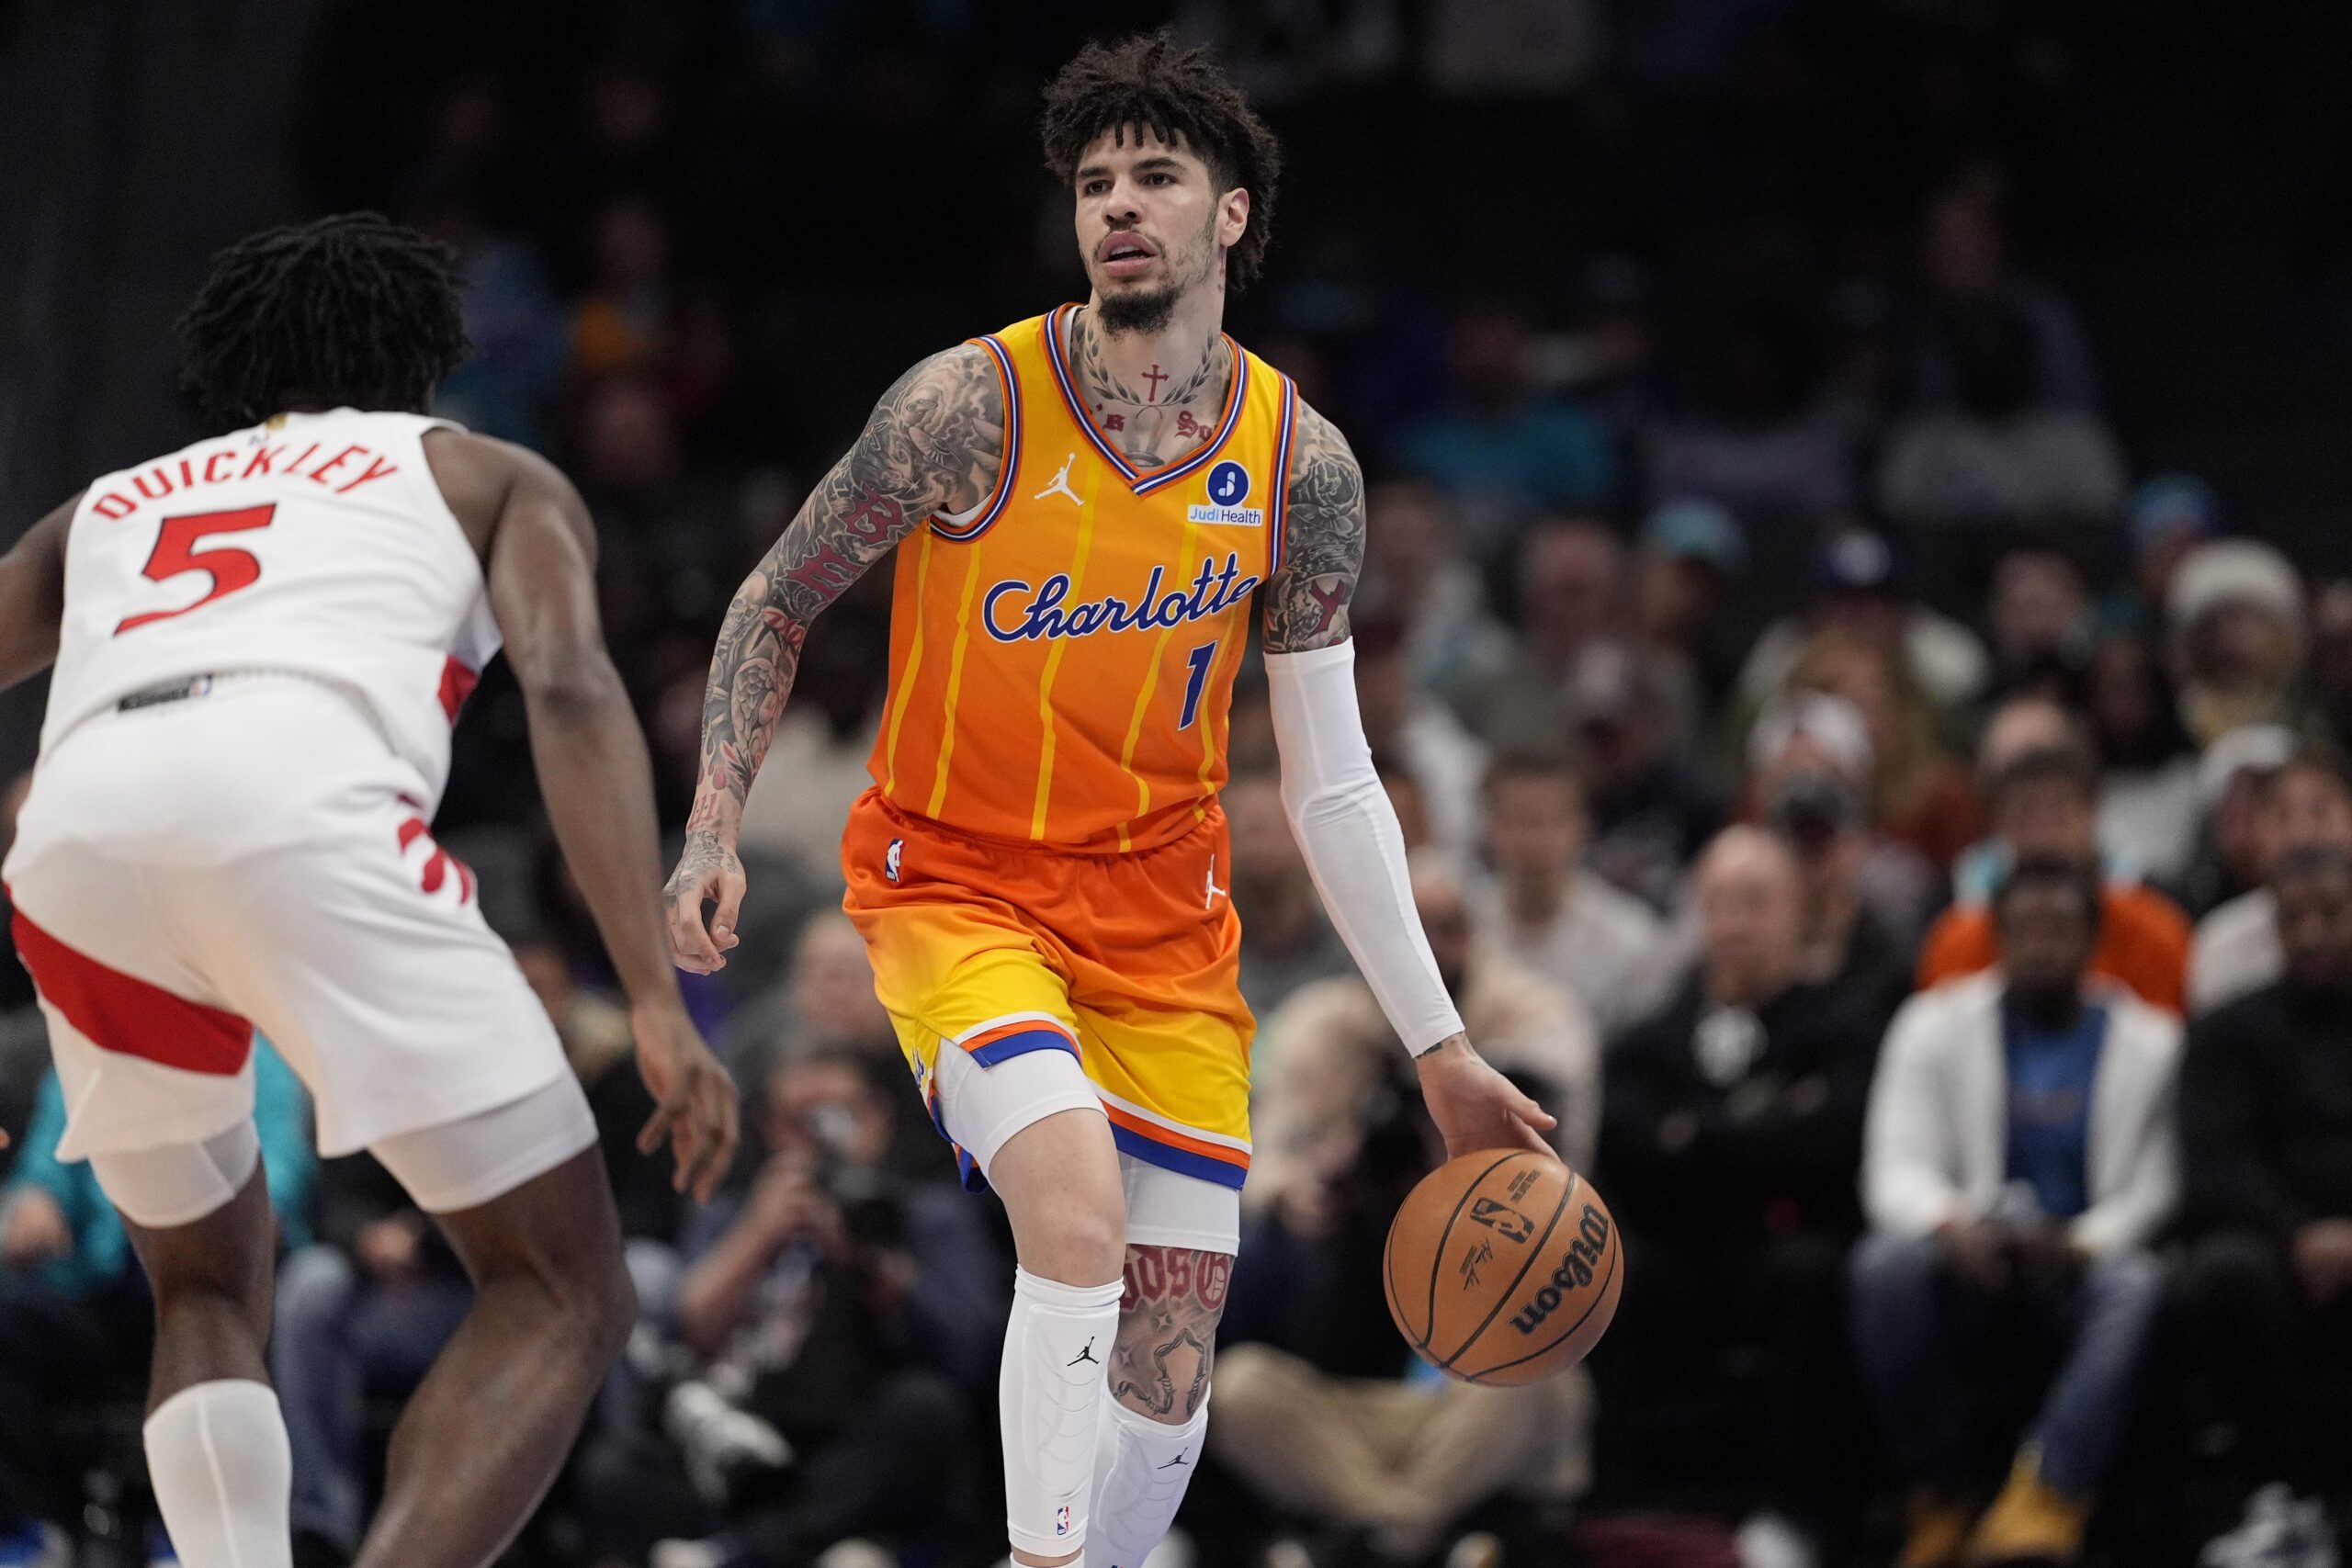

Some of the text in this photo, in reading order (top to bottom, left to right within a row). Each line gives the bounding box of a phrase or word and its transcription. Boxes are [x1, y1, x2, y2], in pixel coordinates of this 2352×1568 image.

[93, 442, 399, 521] QUICKLEY
[1190, 507, 1261, 524] Judi Health
[112, 501, 277, 637] 5
[983, 551, 1260, 642] Charlotte
[1178, 639, 1217, 731] 1
[1508, 1201, 1609, 1335] Wilson
